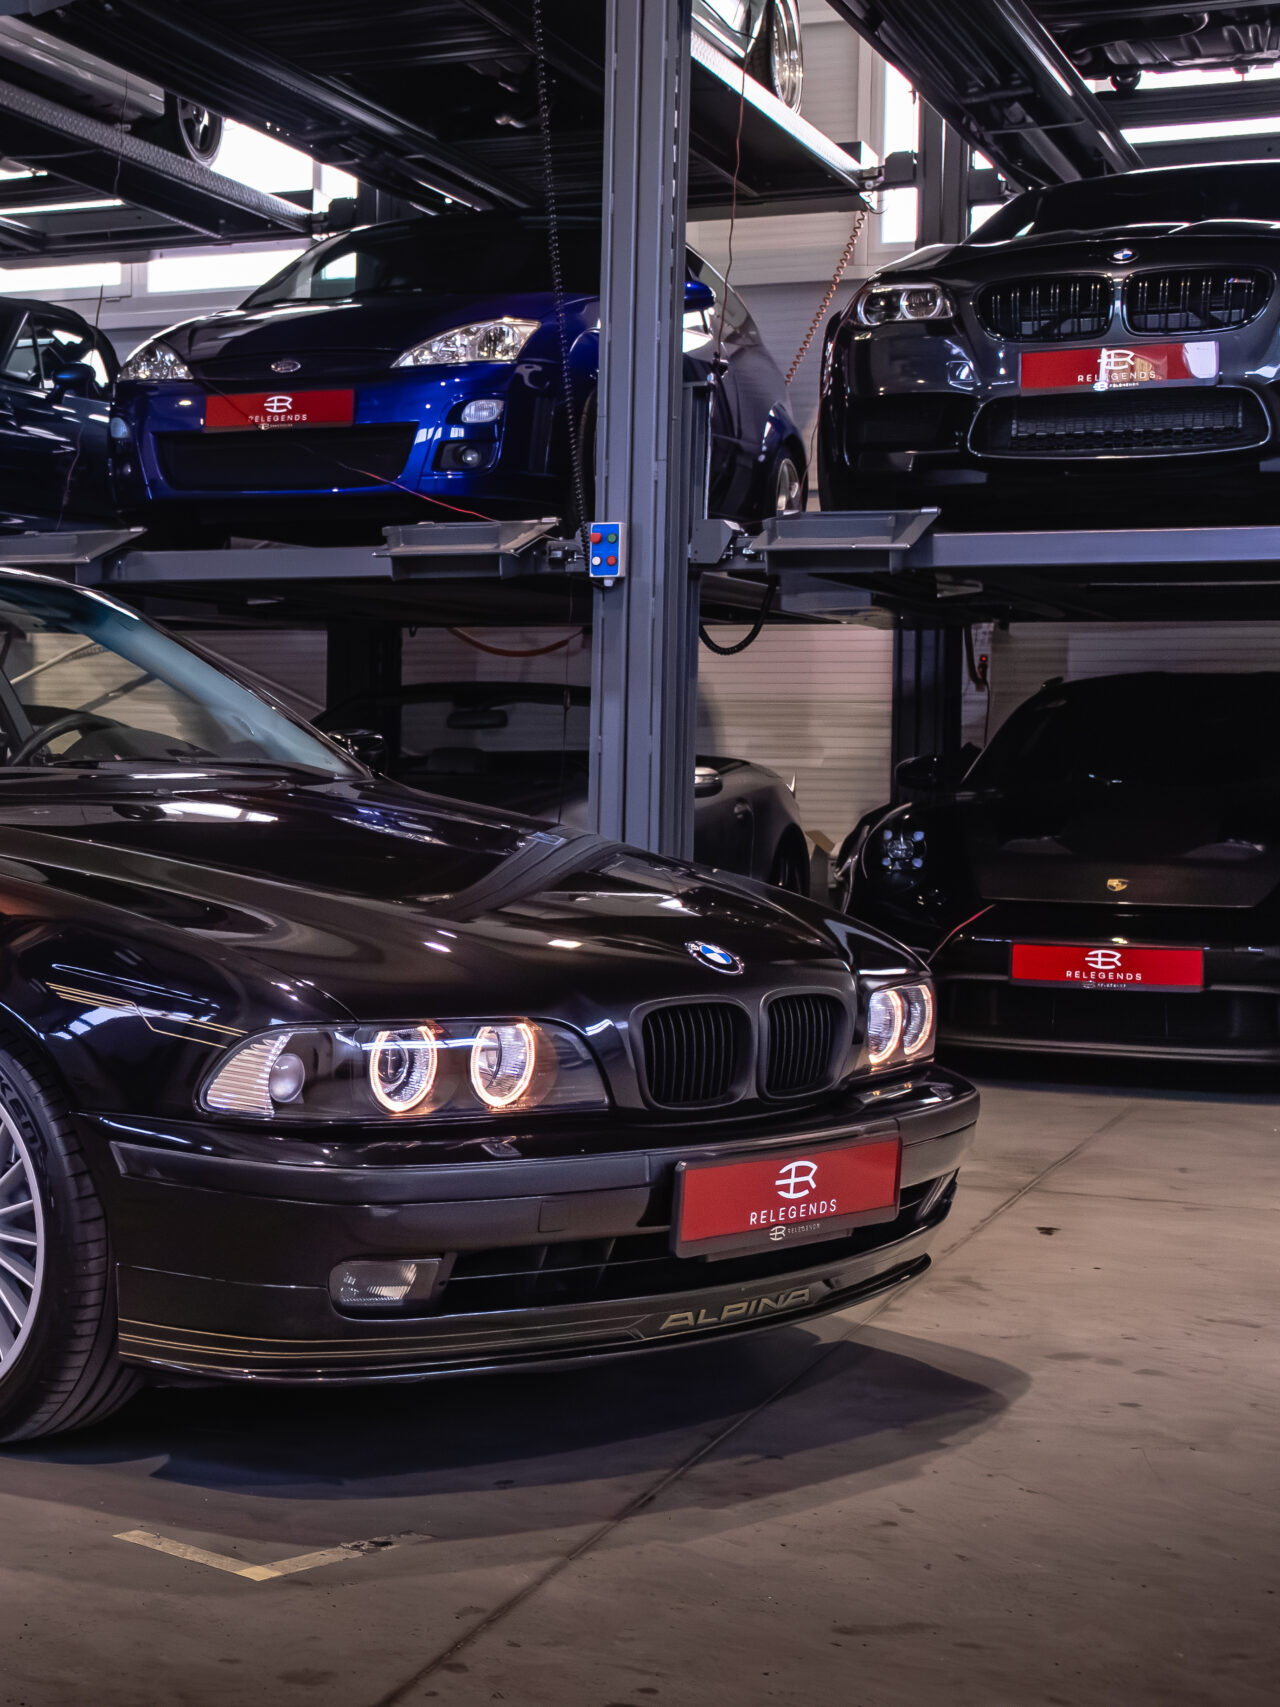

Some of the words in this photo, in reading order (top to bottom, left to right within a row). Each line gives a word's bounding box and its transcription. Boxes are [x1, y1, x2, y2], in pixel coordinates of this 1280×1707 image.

[1077, 370, 1157, 383] RELGENDS
[1065, 970, 1142, 981] RELEGENDS
[749, 1199, 837, 1226] RELEGENDS
[659, 1288, 810, 1330] ALPINA
